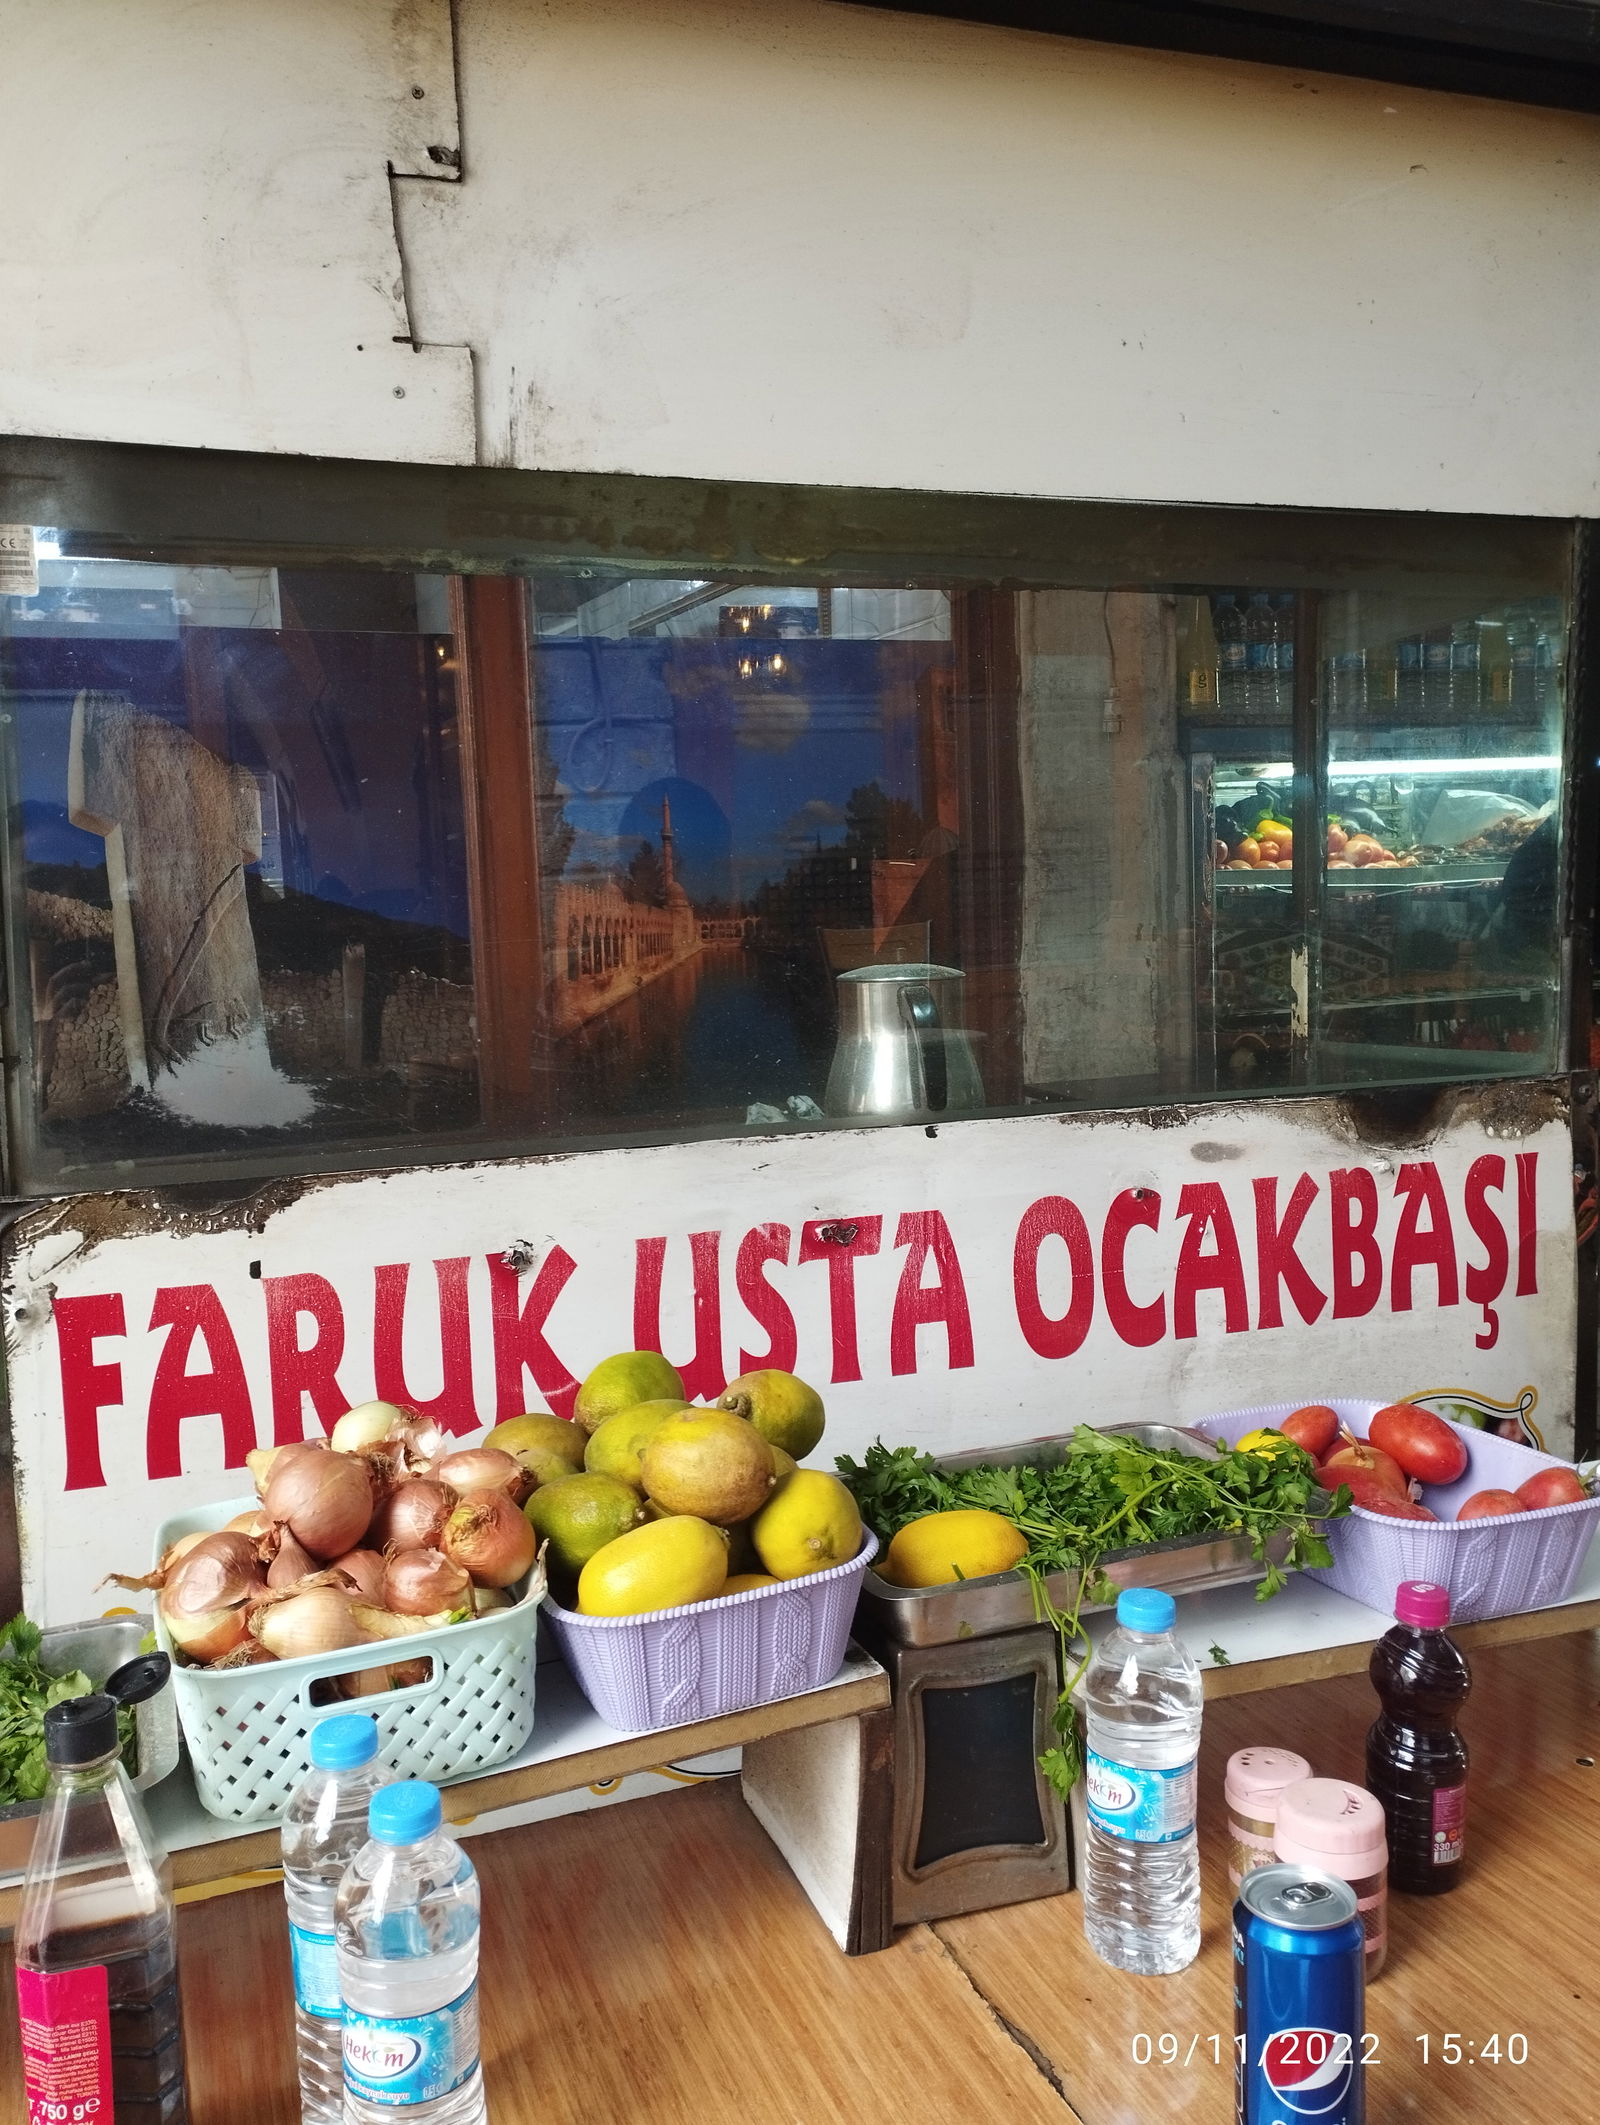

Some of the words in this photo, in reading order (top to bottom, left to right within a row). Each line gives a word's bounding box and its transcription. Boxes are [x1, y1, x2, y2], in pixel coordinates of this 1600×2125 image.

[52, 1245, 578, 1491] FARUK
[633, 1209, 975, 1401] USTA
[1012, 1151, 1540, 1360] OCAKBAŞI
